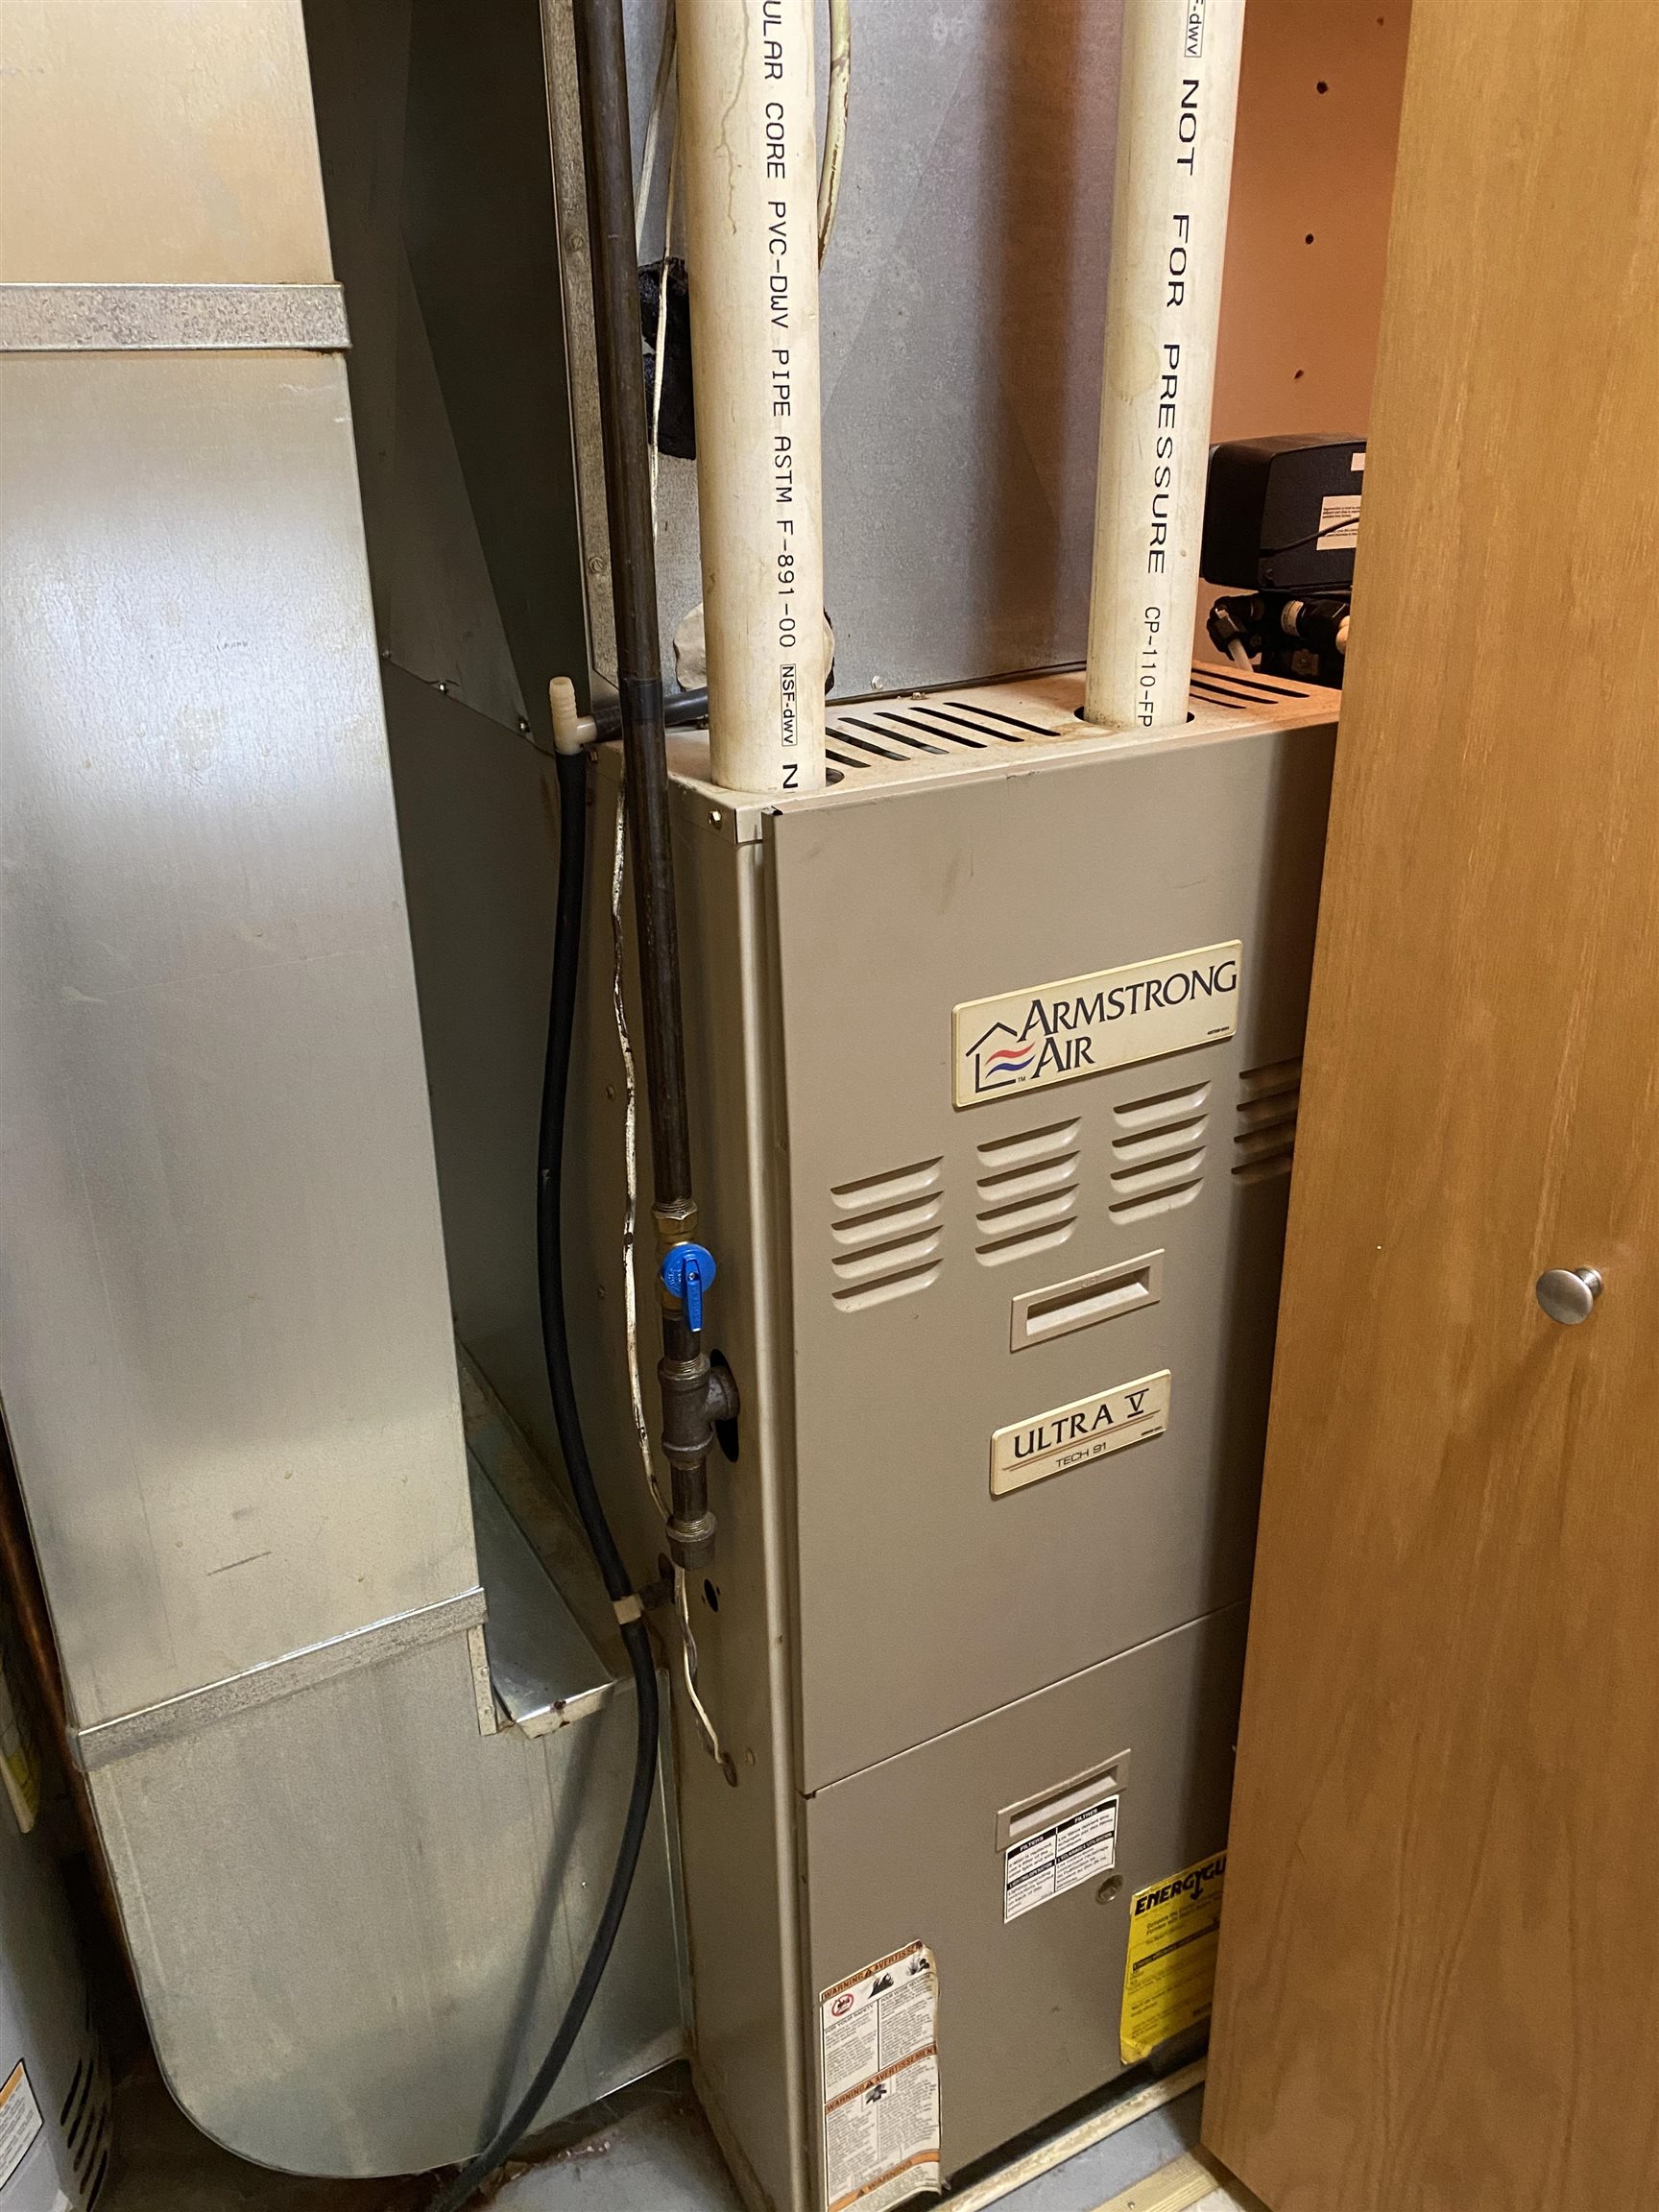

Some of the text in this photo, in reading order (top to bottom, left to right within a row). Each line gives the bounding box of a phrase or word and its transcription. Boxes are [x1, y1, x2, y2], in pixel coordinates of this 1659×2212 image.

[1176, 79, 1199, 176] NOT
[1166, 214, 1190, 307] FOR
[762, 0, 799, 789] ULAR CORE PVC-DWV PIPE ASTM F-891-00 NSF-dwv N
[1147, 344, 1180, 574] PRESSURE
[1138, 607, 1161, 728] CP-110-FP
[1017, 960, 1237, 1043] ARMSTRONG
[1030, 1036, 1095, 1079] AIR
[1014, 1388, 1149, 1458] ULTRA V
[1056, 1441, 1107, 1468] TECH 91
[824, 1973, 863, 1998] WARNING
[827, 2083, 864, 2112] WARNING
